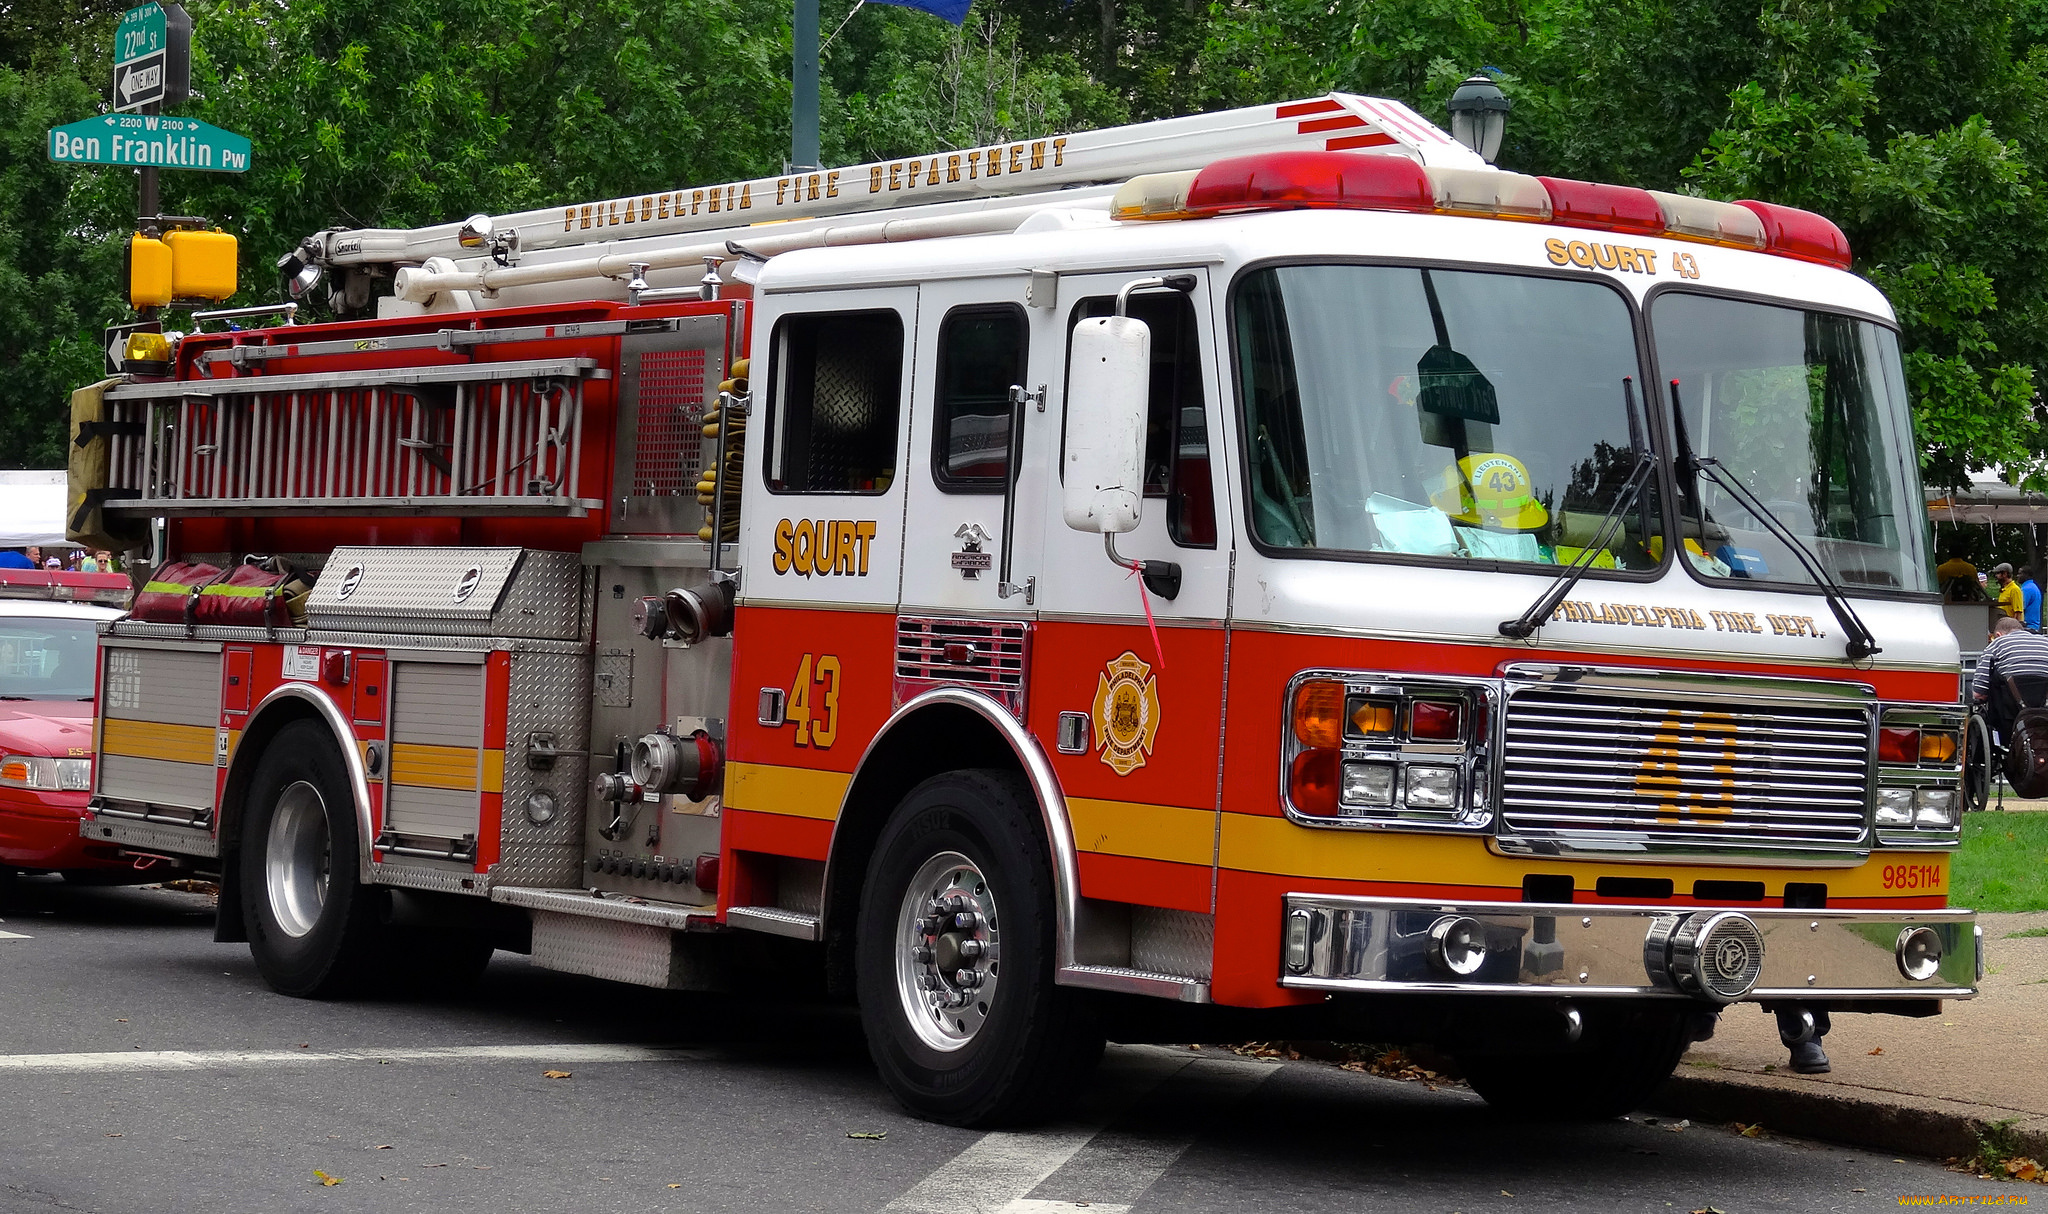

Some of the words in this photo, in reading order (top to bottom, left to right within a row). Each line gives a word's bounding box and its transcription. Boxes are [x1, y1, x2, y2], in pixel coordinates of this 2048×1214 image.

[138, 8, 143, 21] N
[124, 25, 146, 59] 22nd
[150, 31, 157, 50] St
[131, 73, 144, 92] ONE
[144, 67, 159, 86] WAY
[120, 117, 142, 129] 2200
[145, 117, 159, 131] W
[162, 120, 184, 131] 2100
[55, 131, 100, 161] Ben
[112, 134, 212, 167] Franklin
[565, 183, 753, 232] PHILADELPHIA
[777, 171, 840, 206] FIRE
[869, 137, 1067, 193] DEPARTMENT
[1545, 238, 1657, 275] SQURT
[1672, 252, 1700, 279] 43
[1475, 459, 1523, 480] LIEUTENANT
[1489, 471, 1516, 493] 43
[773, 518, 877, 581] SQURT
[1552, 600, 1706, 630] PHILADELPHIA
[1709, 610, 1763, 635] FIRE
[1766, 613, 1826, 638] DEPT.
[110, 652, 140, 674] DIAL
[108, 674, 140, 708] 911
[1109, 671, 1145, 692] PHILADELPHIA
[785, 653, 841, 749] 43
[1113, 730, 1146, 756] DEPARTMENT
[1883, 865, 1941, 890] 985114
